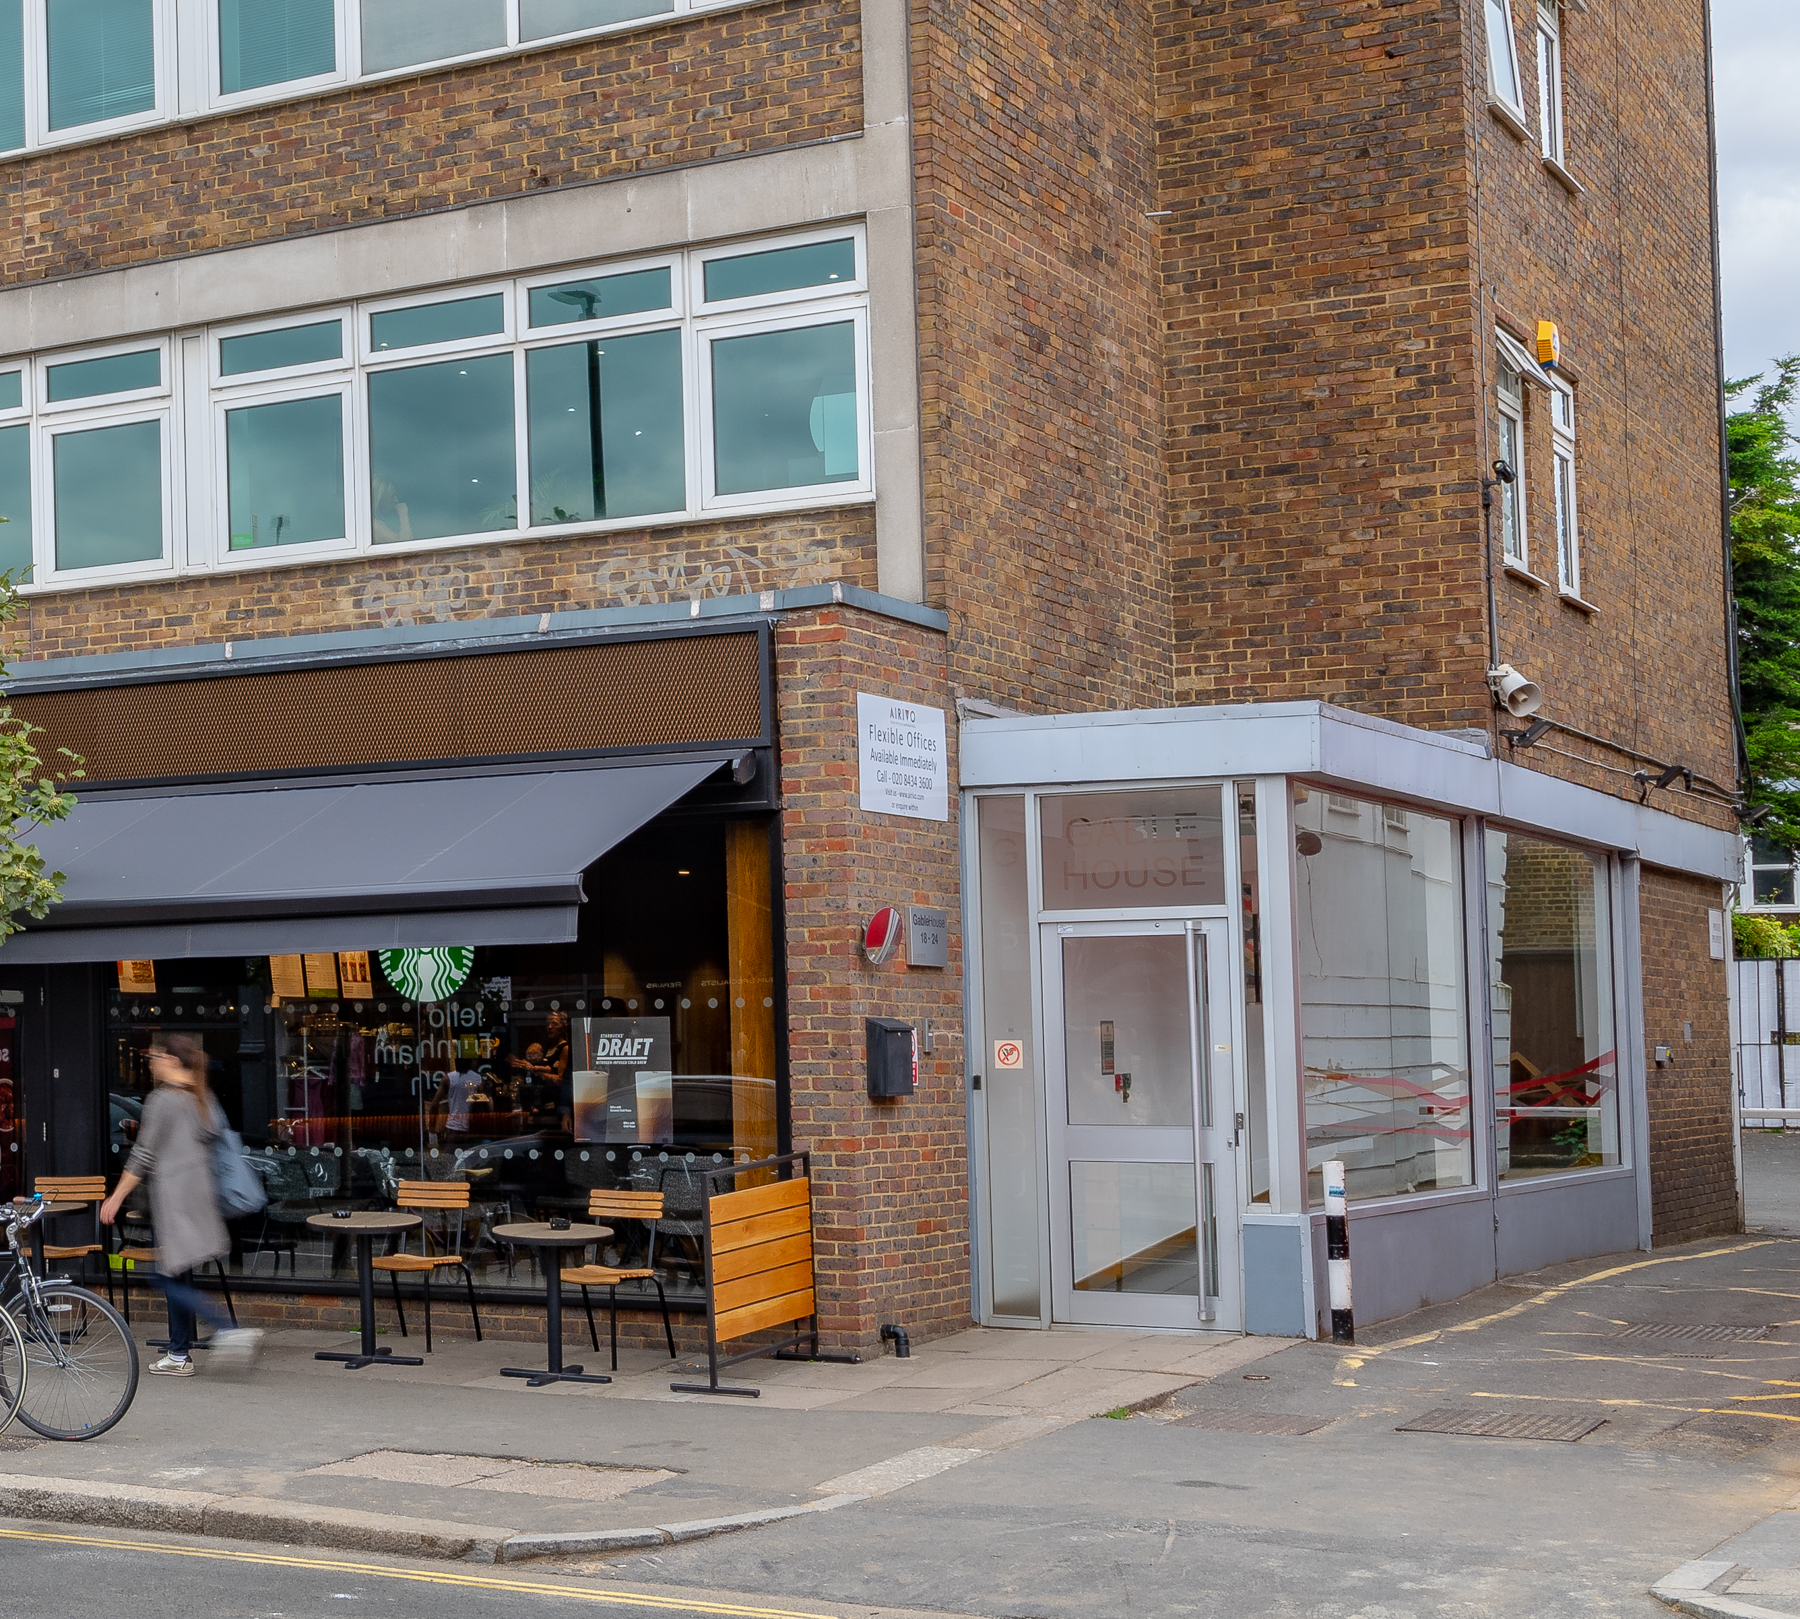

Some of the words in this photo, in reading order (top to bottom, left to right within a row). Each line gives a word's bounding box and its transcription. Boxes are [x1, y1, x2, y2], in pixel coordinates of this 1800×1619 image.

[890, 707, 916, 723] AIRIVO
[869, 724, 903, 746] Flexible
[907, 731, 937, 752] Offices
[870, 748, 899, 765] Available
[900, 753, 937, 774] Immediately
[877, 770, 888, 783] Call
[892, 772, 903, 786] 020
[919, 776, 933, 790] 3600
[1063, 855, 1205, 890] HOUSE
[920, 932, 927, 944] 18
[931, 934, 939, 945] 24
[597, 1038, 654, 1056] DRAFT
